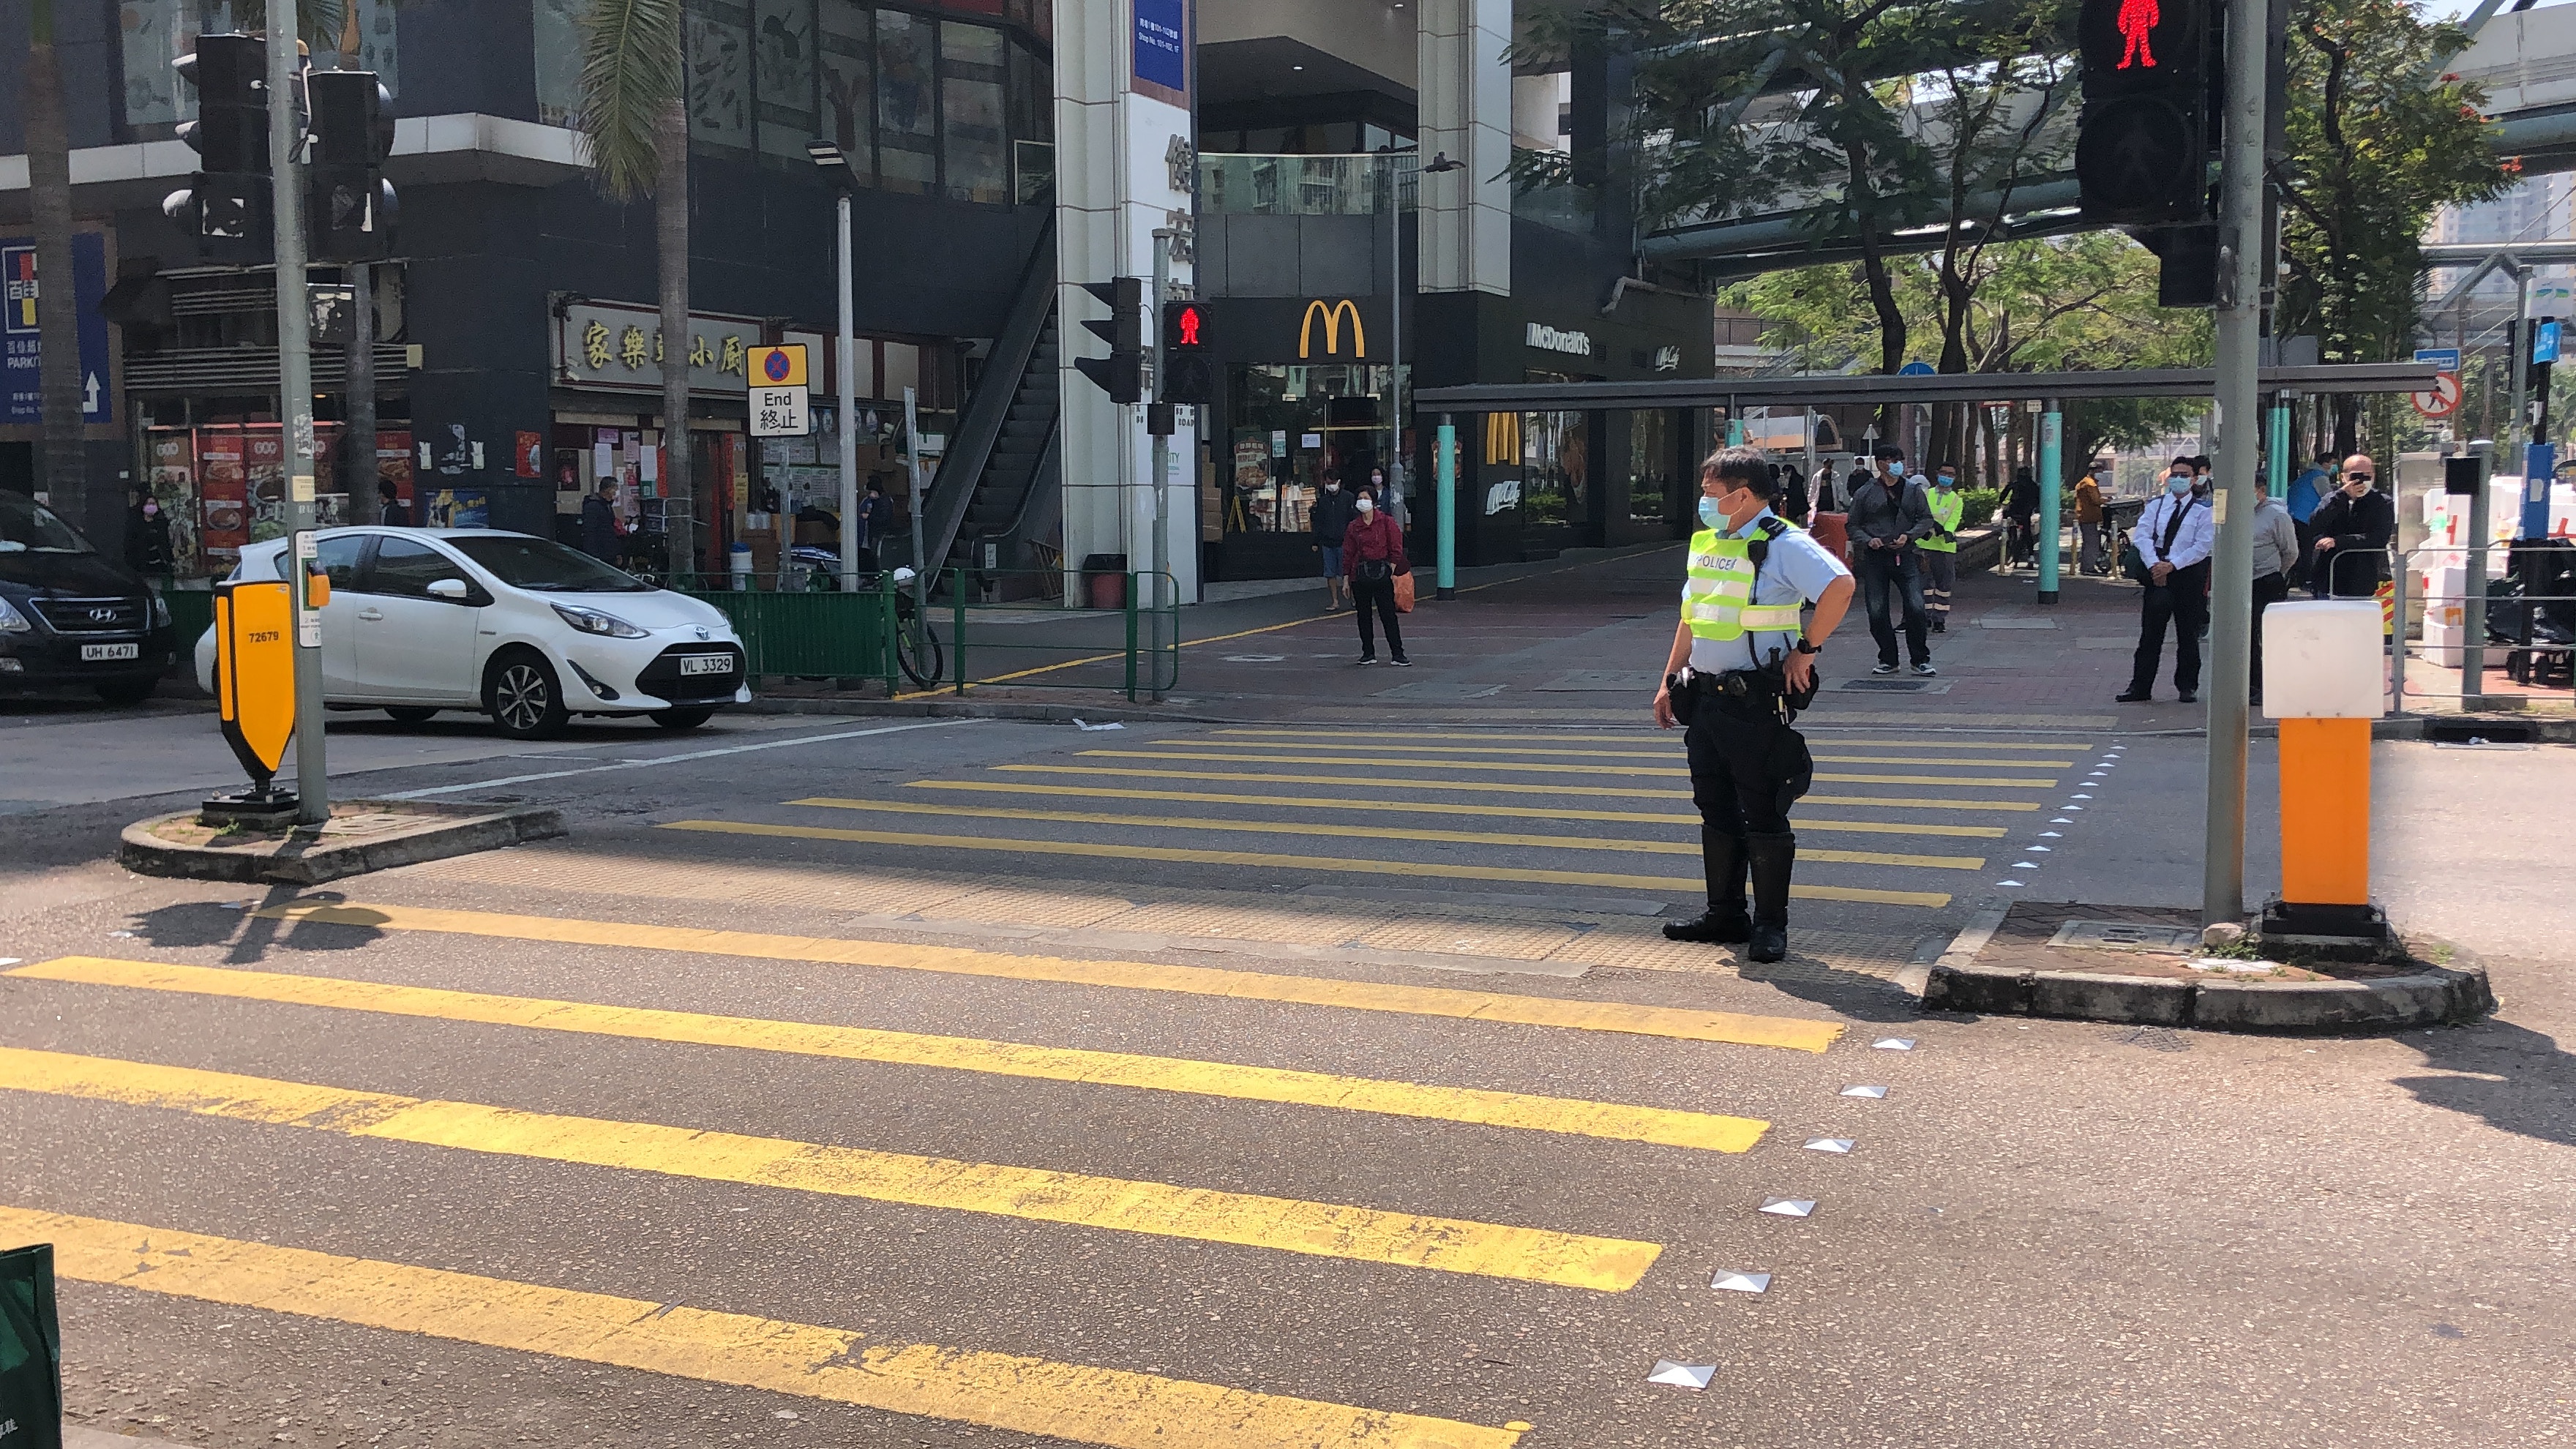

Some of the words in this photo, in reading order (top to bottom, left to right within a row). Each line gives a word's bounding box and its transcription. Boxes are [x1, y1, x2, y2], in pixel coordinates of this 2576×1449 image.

[1526, 322, 1590, 356] McDonald's
[764, 392, 792, 406] End
[760, 408, 798, 430] 終止
[1695, 555, 1731, 570] POLICE
[249, 631, 280, 643] 72679
[86, 647, 102, 658] UH
[107, 645, 134, 657] 6471
[683, 659, 698, 673] VL
[702, 658, 731, 671] 3329
